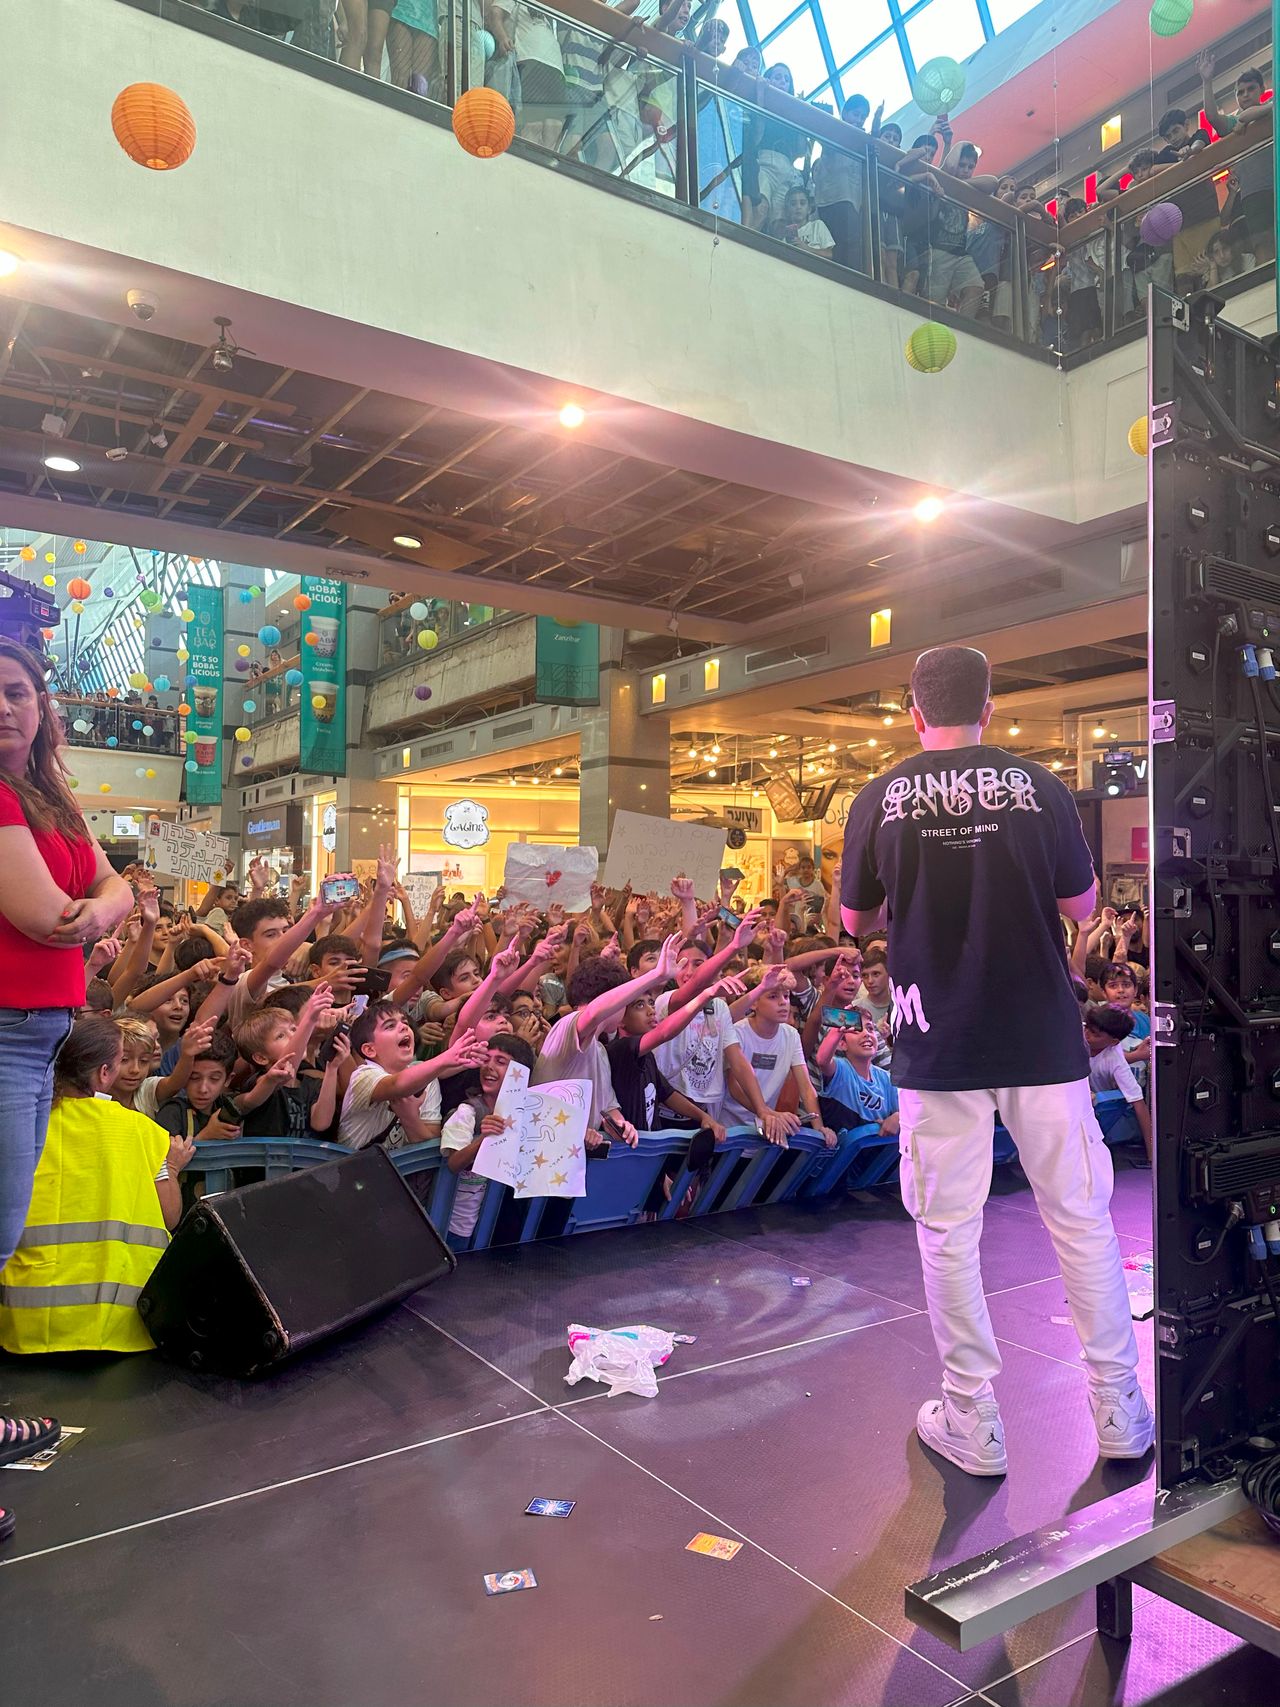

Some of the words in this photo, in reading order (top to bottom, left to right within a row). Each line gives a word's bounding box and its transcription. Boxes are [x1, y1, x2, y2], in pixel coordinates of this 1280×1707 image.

[307, 592, 342, 605] LICIOUS
[194, 627, 217, 639] TEA
[192, 654, 207, 662] IT'S
[192, 662, 219, 670] BOBA-
[190, 669, 221, 678] LICIOUS
[921, 827, 958, 837] STREET
[959, 826, 973, 835] OF
[974, 823, 999, 834] MIND
[171, 856, 211, 884] אותי
